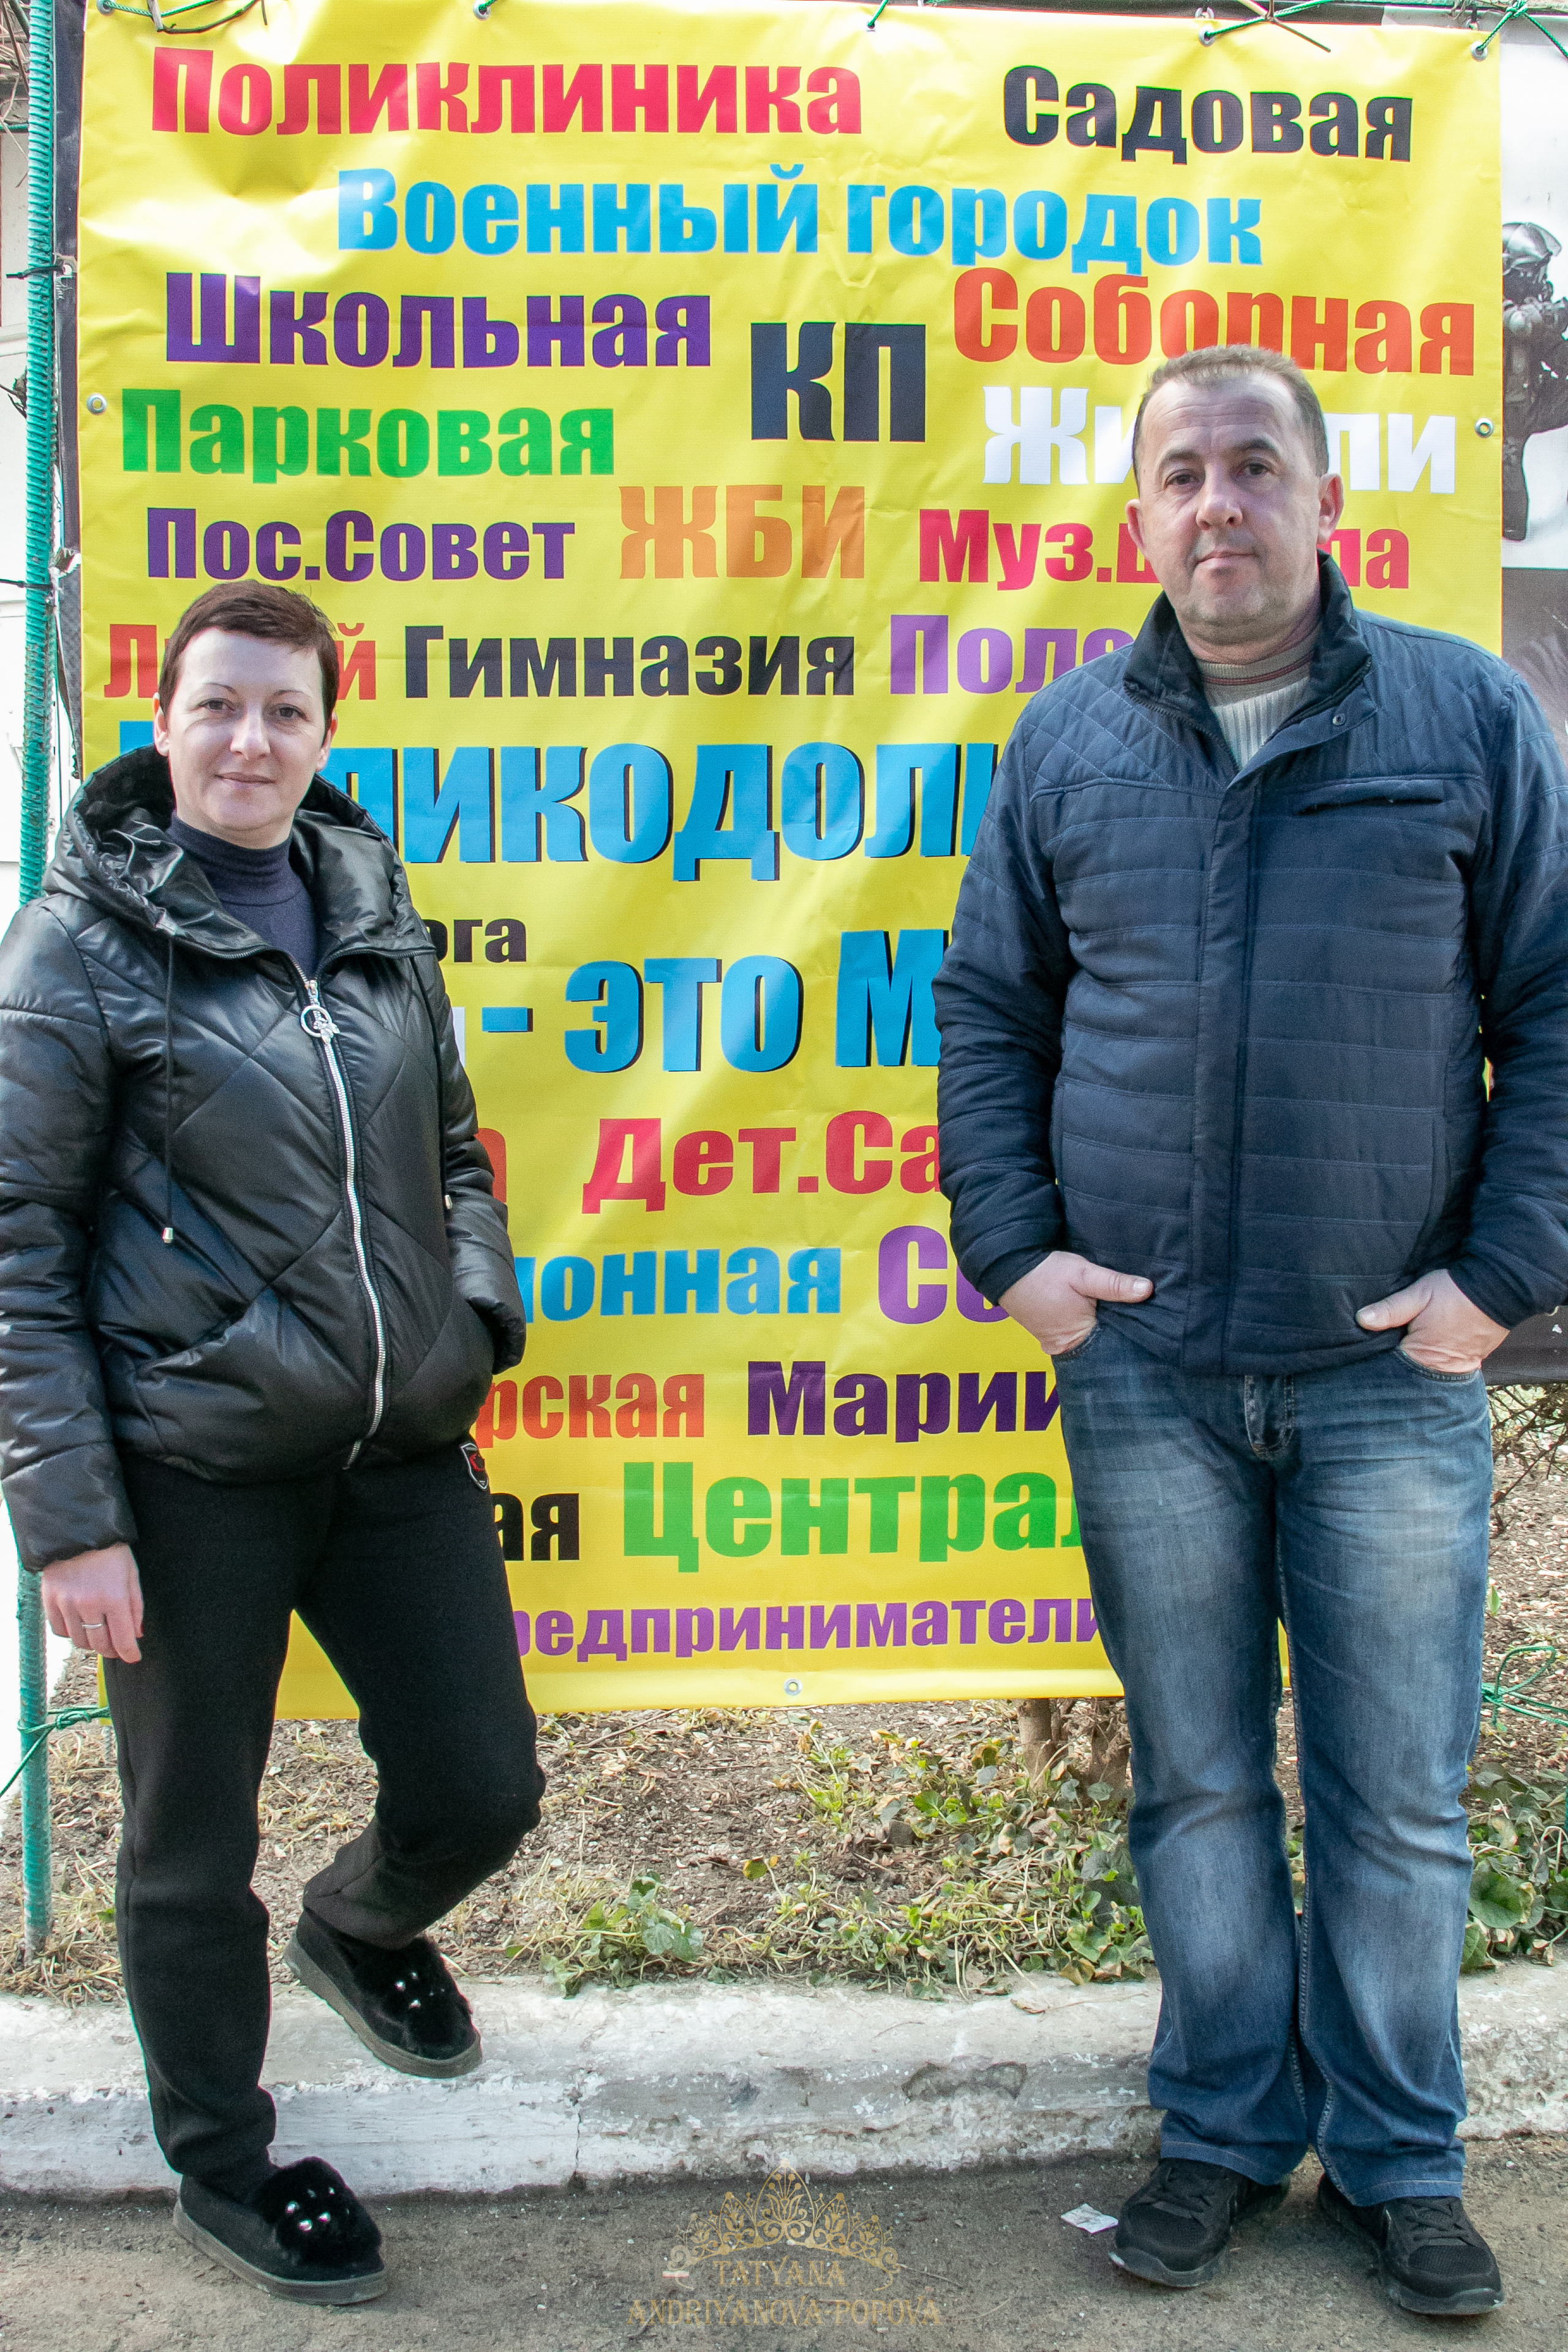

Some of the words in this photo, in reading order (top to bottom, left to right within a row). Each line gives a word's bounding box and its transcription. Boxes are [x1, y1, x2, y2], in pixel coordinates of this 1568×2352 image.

[152, 47, 862, 135] Поликлиника
[1003, 65, 1413, 165] Садовая
[338, 163, 818, 256] Военный
[847, 184, 1263, 276] городок
[166, 272, 711, 369] Школьная
[953, 267, 1475, 376] Соборная
[750, 322, 926, 443] КП
[122, 388, 614, 484] Парковая
[982, 385, 1456, 494] Жили
[147, 507, 576, 581] Пос.Совет
[619, 484, 865, 580] ЖБИ
[404, 625, 855, 698] Гимназия
[834, 929, 949, 1068] М
[582, 1109, 940, 1215] Дет.Са
[475, 1372, 705, 1449] рская
[747, 1360, 1061, 1443] Марии
[491, 1492, 580, 1561] ая
